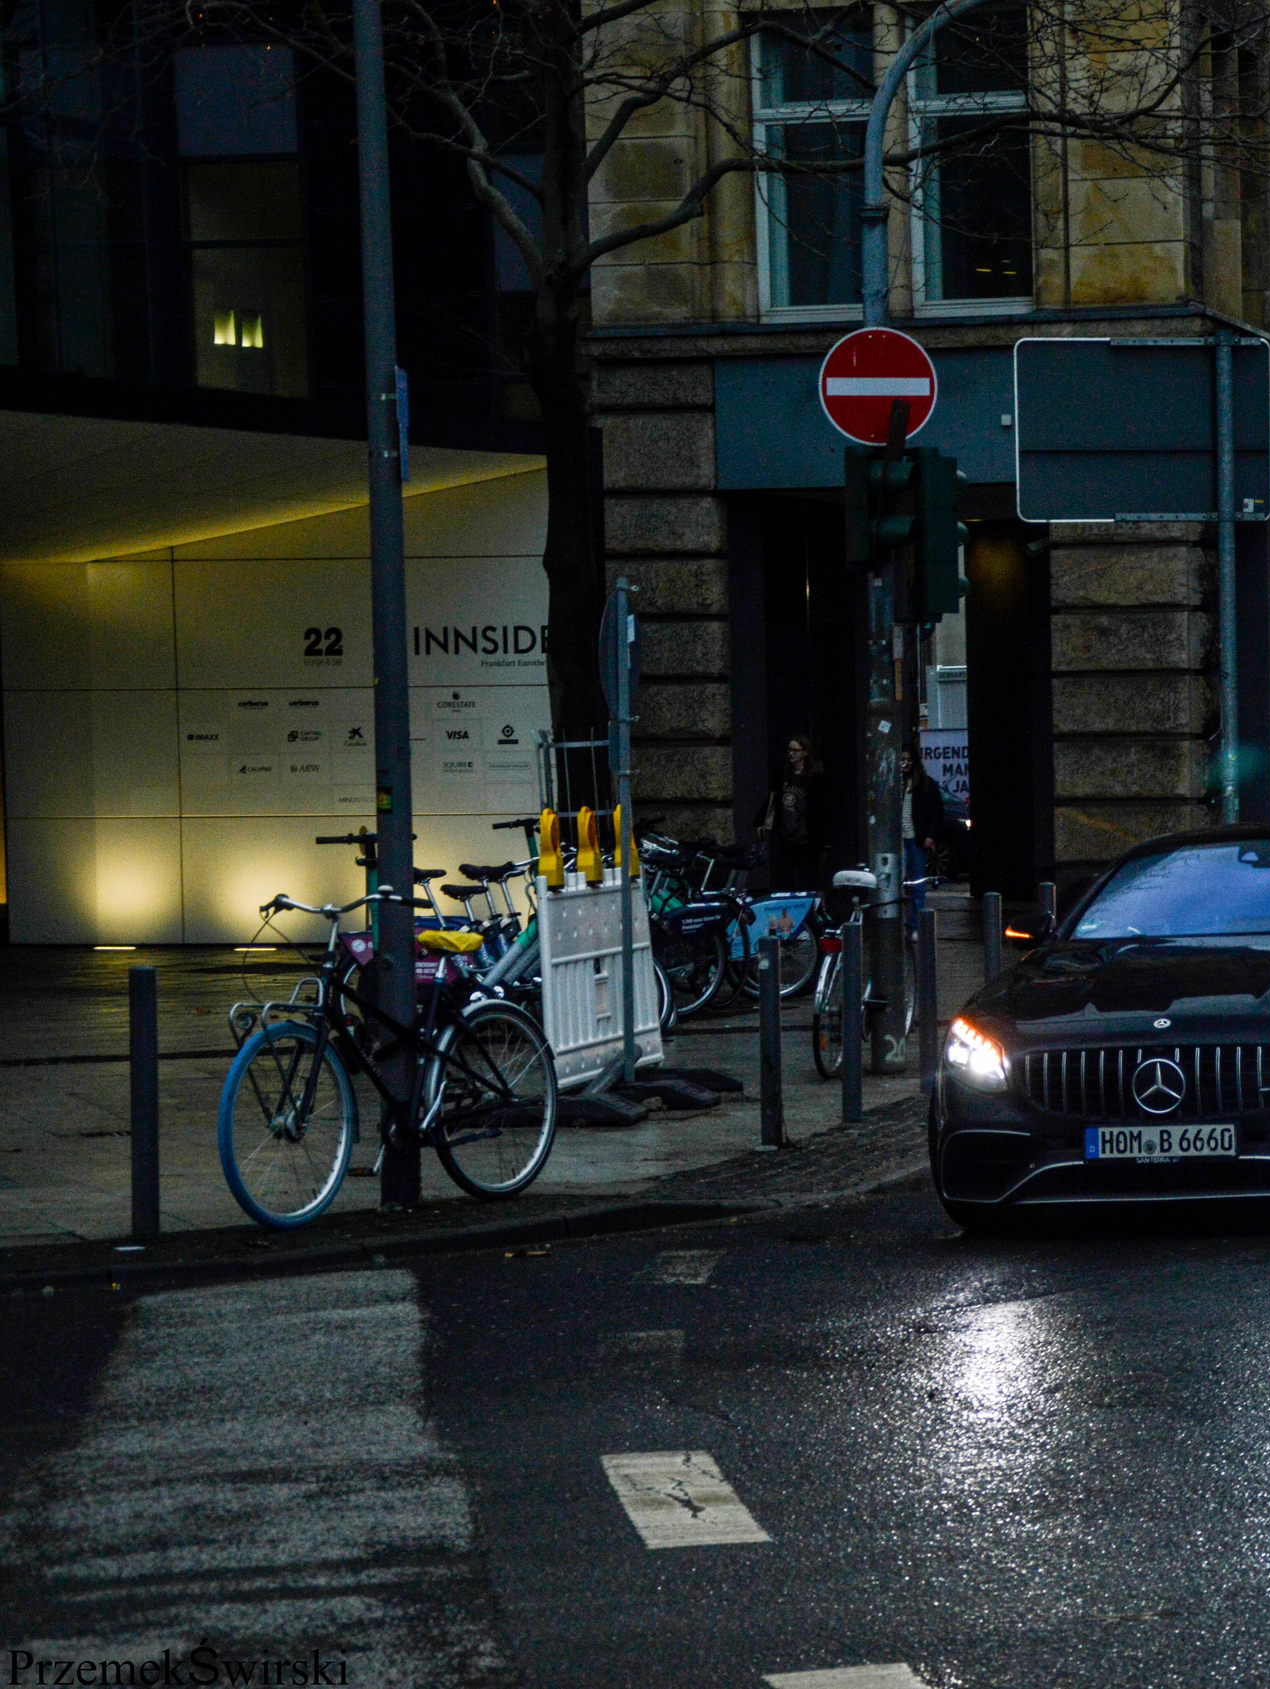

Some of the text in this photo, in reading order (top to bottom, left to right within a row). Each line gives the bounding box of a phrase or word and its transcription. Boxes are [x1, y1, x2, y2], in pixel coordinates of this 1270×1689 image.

[304, 627, 343, 656] 22
[446, 730, 469, 740] VISA
[1101, 1128, 1233, 1154] HOM B 6660
